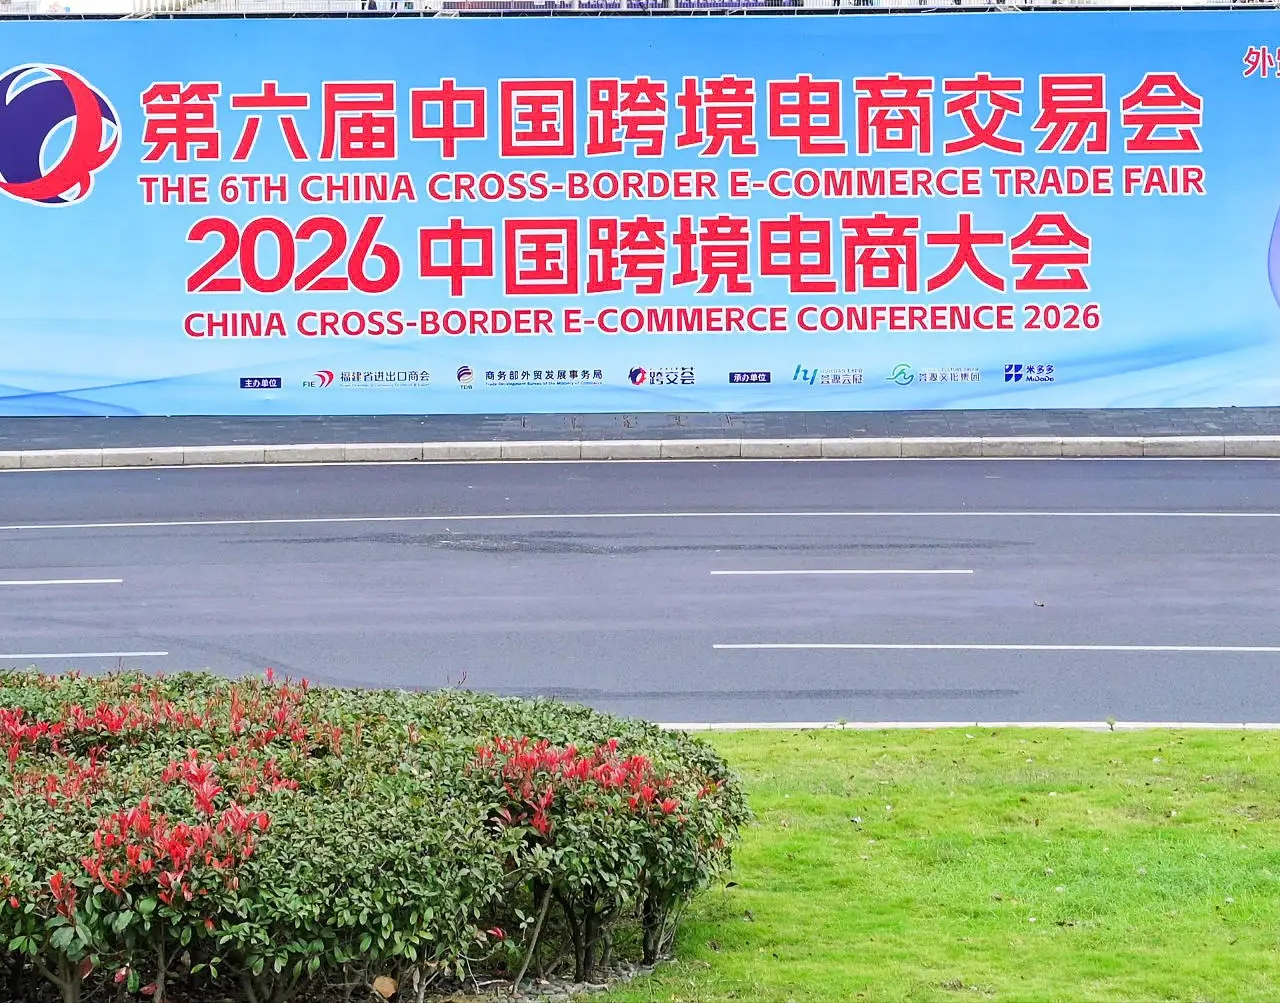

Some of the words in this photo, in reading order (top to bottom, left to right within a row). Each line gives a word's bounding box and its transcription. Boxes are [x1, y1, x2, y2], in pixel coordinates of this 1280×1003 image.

[140, 73, 1202, 162] 第六届中国跨境电商交易会
[140, 177, 208, 203] THE
[221, 176, 287, 202] 6TH
[300, 175, 415, 202] CHINA
[428, 172, 717, 201] CROSS-BORDER
[730, 169, 981, 198] E-COMMERCE
[993, 168, 1112, 195] TRADE
[1124, 167, 1204, 194] FAIR
[184, 312, 287, 338] CHINA
[297, 310, 553, 337] CROSS-BORDER
[564, 307, 788, 334] E-COMMERCE
[797, 306, 1014, 332] CONFERENCE
[1024, 305, 1100, 330] 2026
[1026, 365, 1054, 373] 米多多
[340, 371, 430, 382] 福建省进出口商会
[485, 370, 603, 381] 商务部外贸发展事务局
[733, 373, 767, 382] 承办单位
[243, 379, 278, 388] 主办单位
